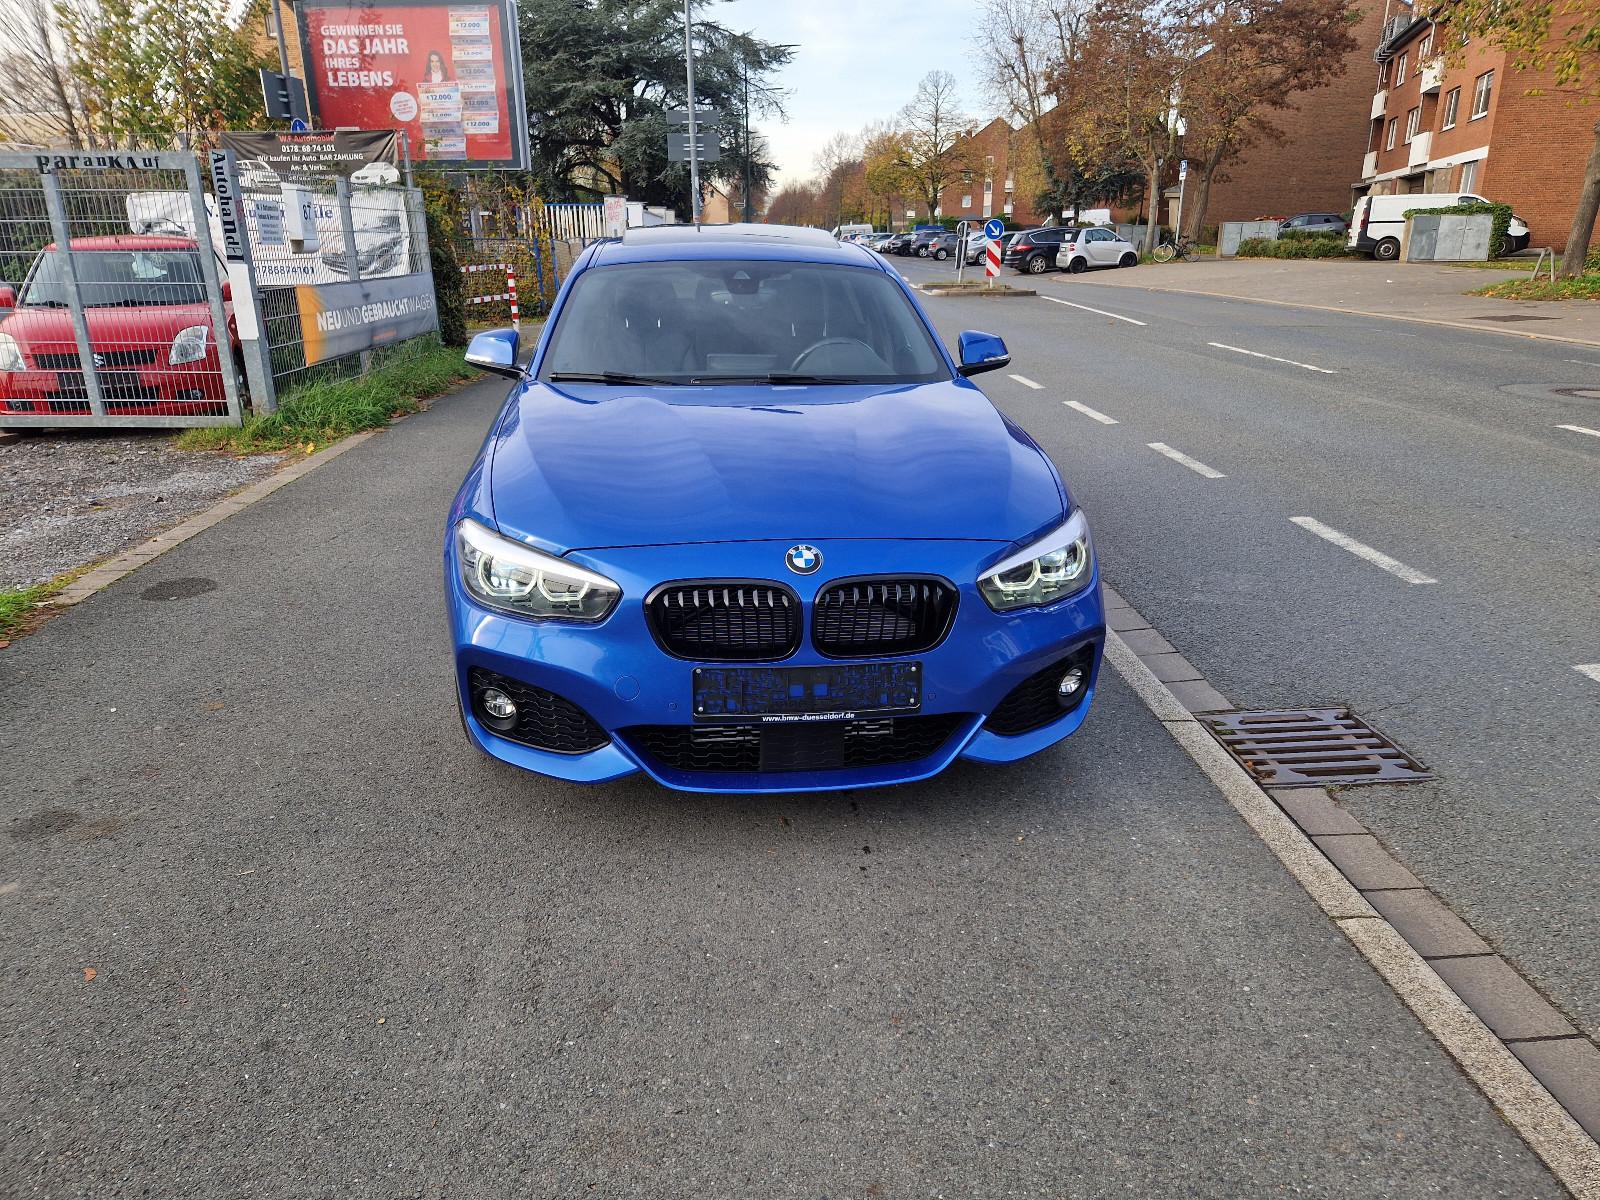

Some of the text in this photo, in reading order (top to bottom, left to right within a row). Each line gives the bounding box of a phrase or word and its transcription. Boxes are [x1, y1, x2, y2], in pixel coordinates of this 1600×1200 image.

[320, 23, 404, 36] GEWINNEN SIE
[322, 38, 409, 55] DAS JAHR
[325, 57, 360, 69] IHRES
[327, 70, 394, 87] LEBENS
[281, 144, 336, 153] 0178 68 74 101
[269, 154, 291, 162] kaufen
[301, 154, 317, 162] Auto
[762, 712, 855, 722] www.bmw-duesseldorf.de
